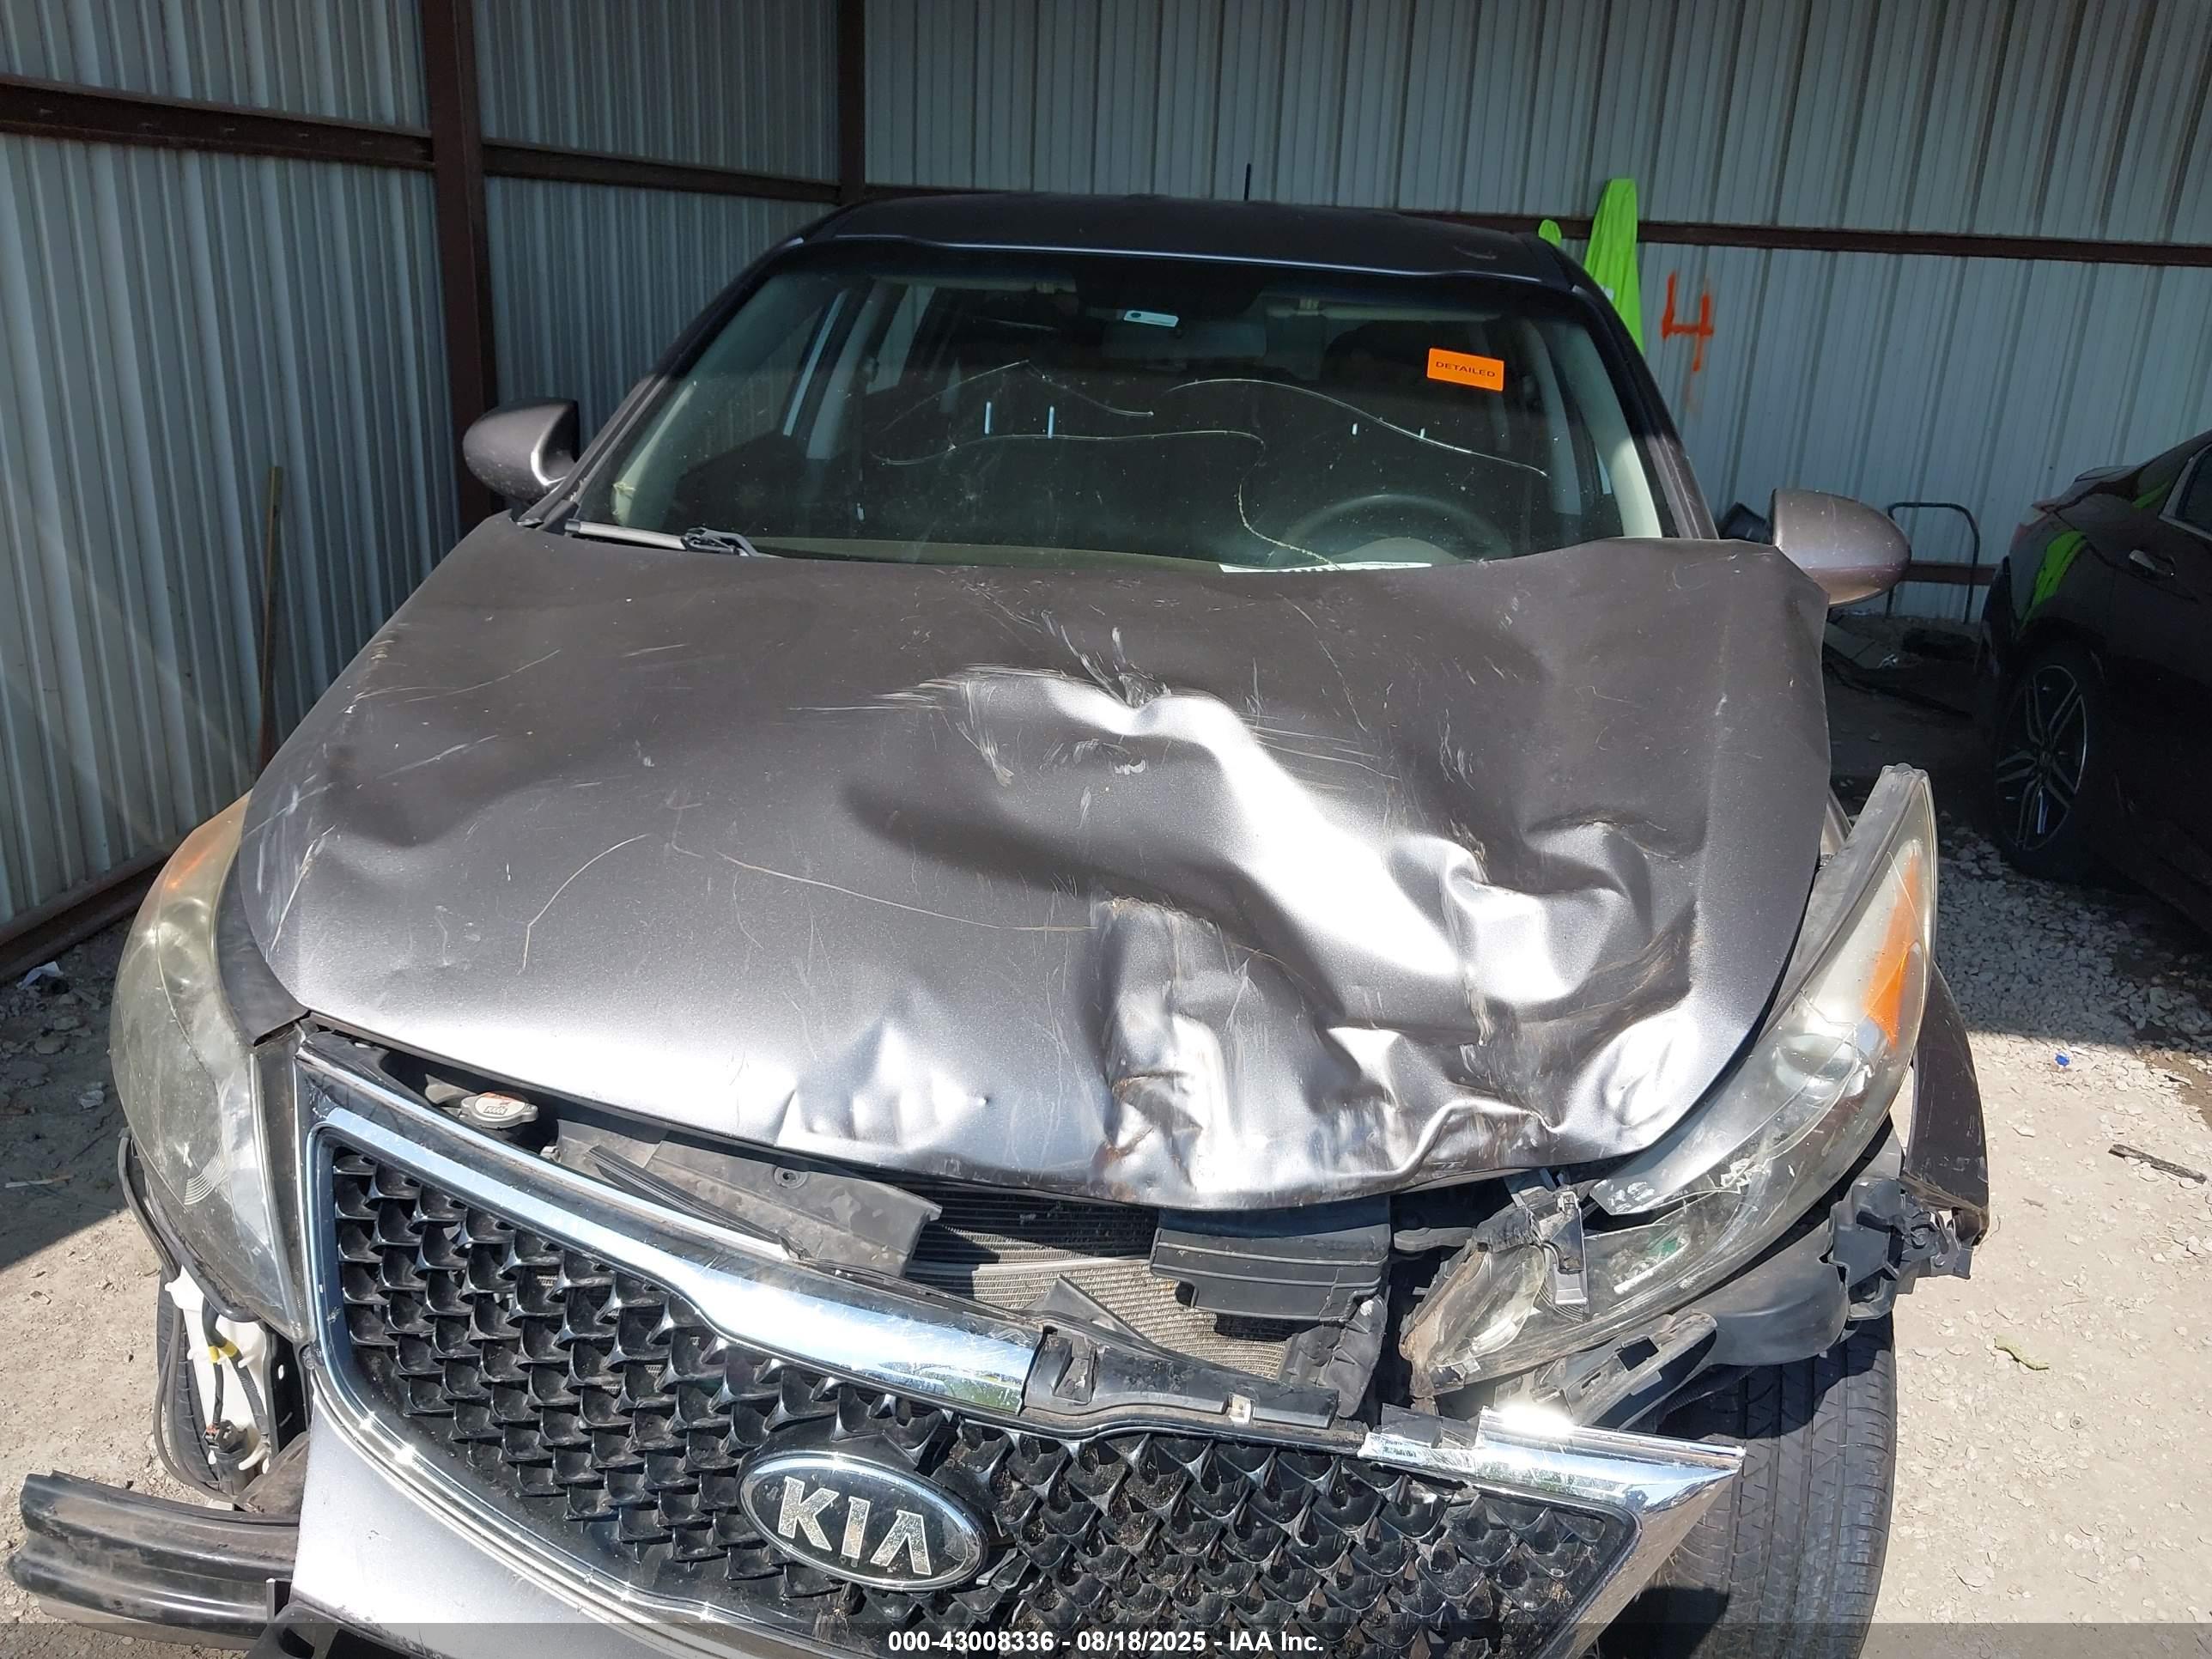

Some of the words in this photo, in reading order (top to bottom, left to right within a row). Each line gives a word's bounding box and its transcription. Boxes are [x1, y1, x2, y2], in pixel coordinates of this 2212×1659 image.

[1435, 361, 1496, 378] DETAILED
[1661, 270, 1715, 372] 4
[777, 1475, 933, 1576] KIA
